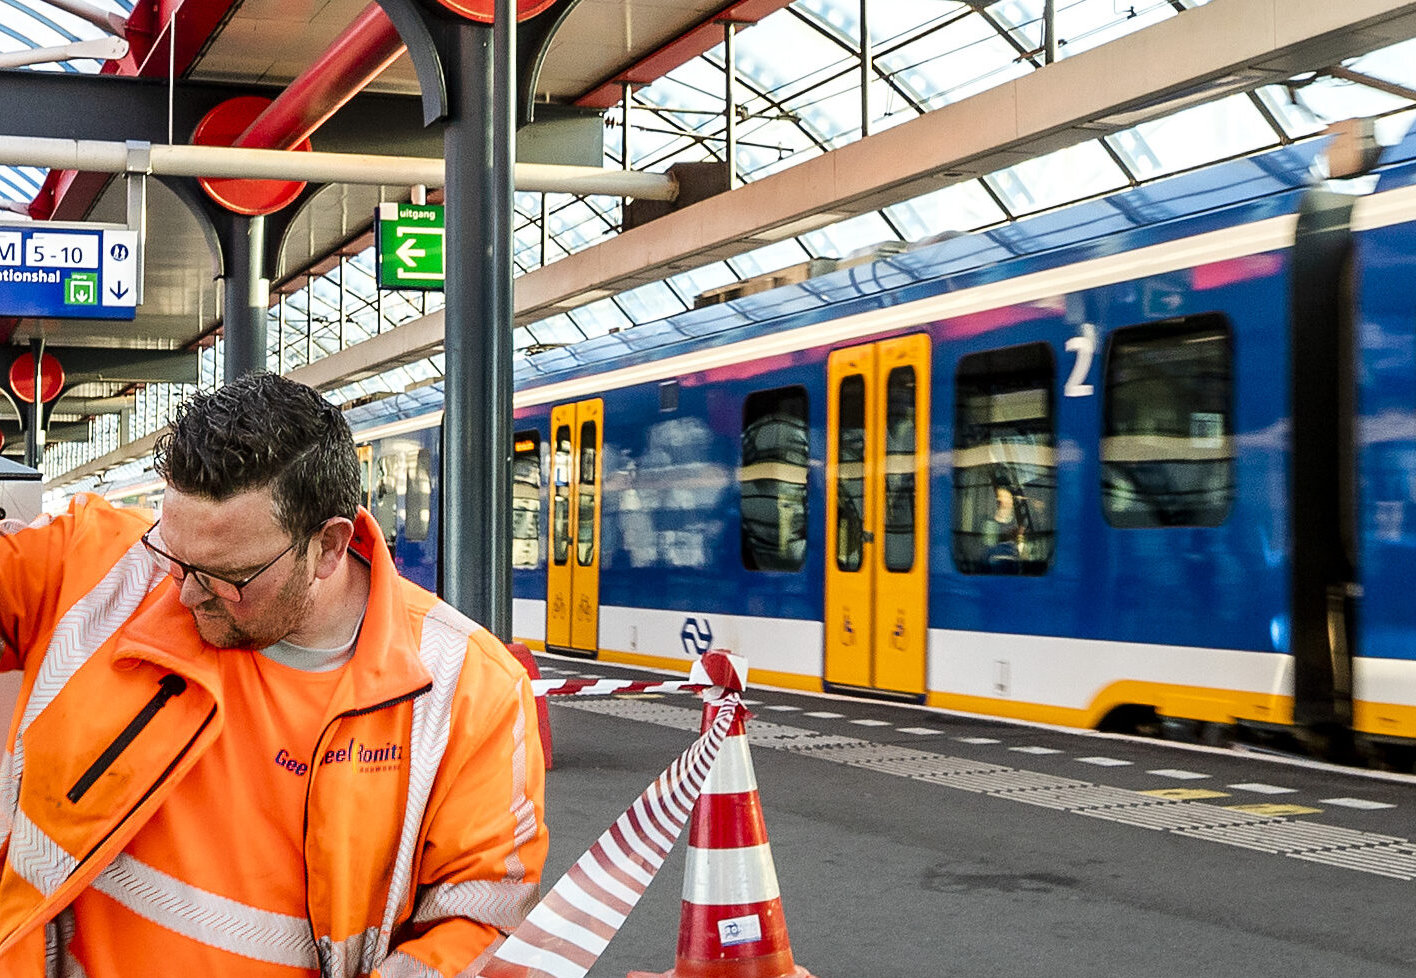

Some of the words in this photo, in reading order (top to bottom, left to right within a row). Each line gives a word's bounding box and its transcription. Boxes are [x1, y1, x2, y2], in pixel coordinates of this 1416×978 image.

[399, 208, 436, 221] uitgang
[34, 245, 45, 262] 5
[61, 246, 83, 264] 10
[1064, 336, 1096, 397] 2
[319, 738, 354, 766] eel
